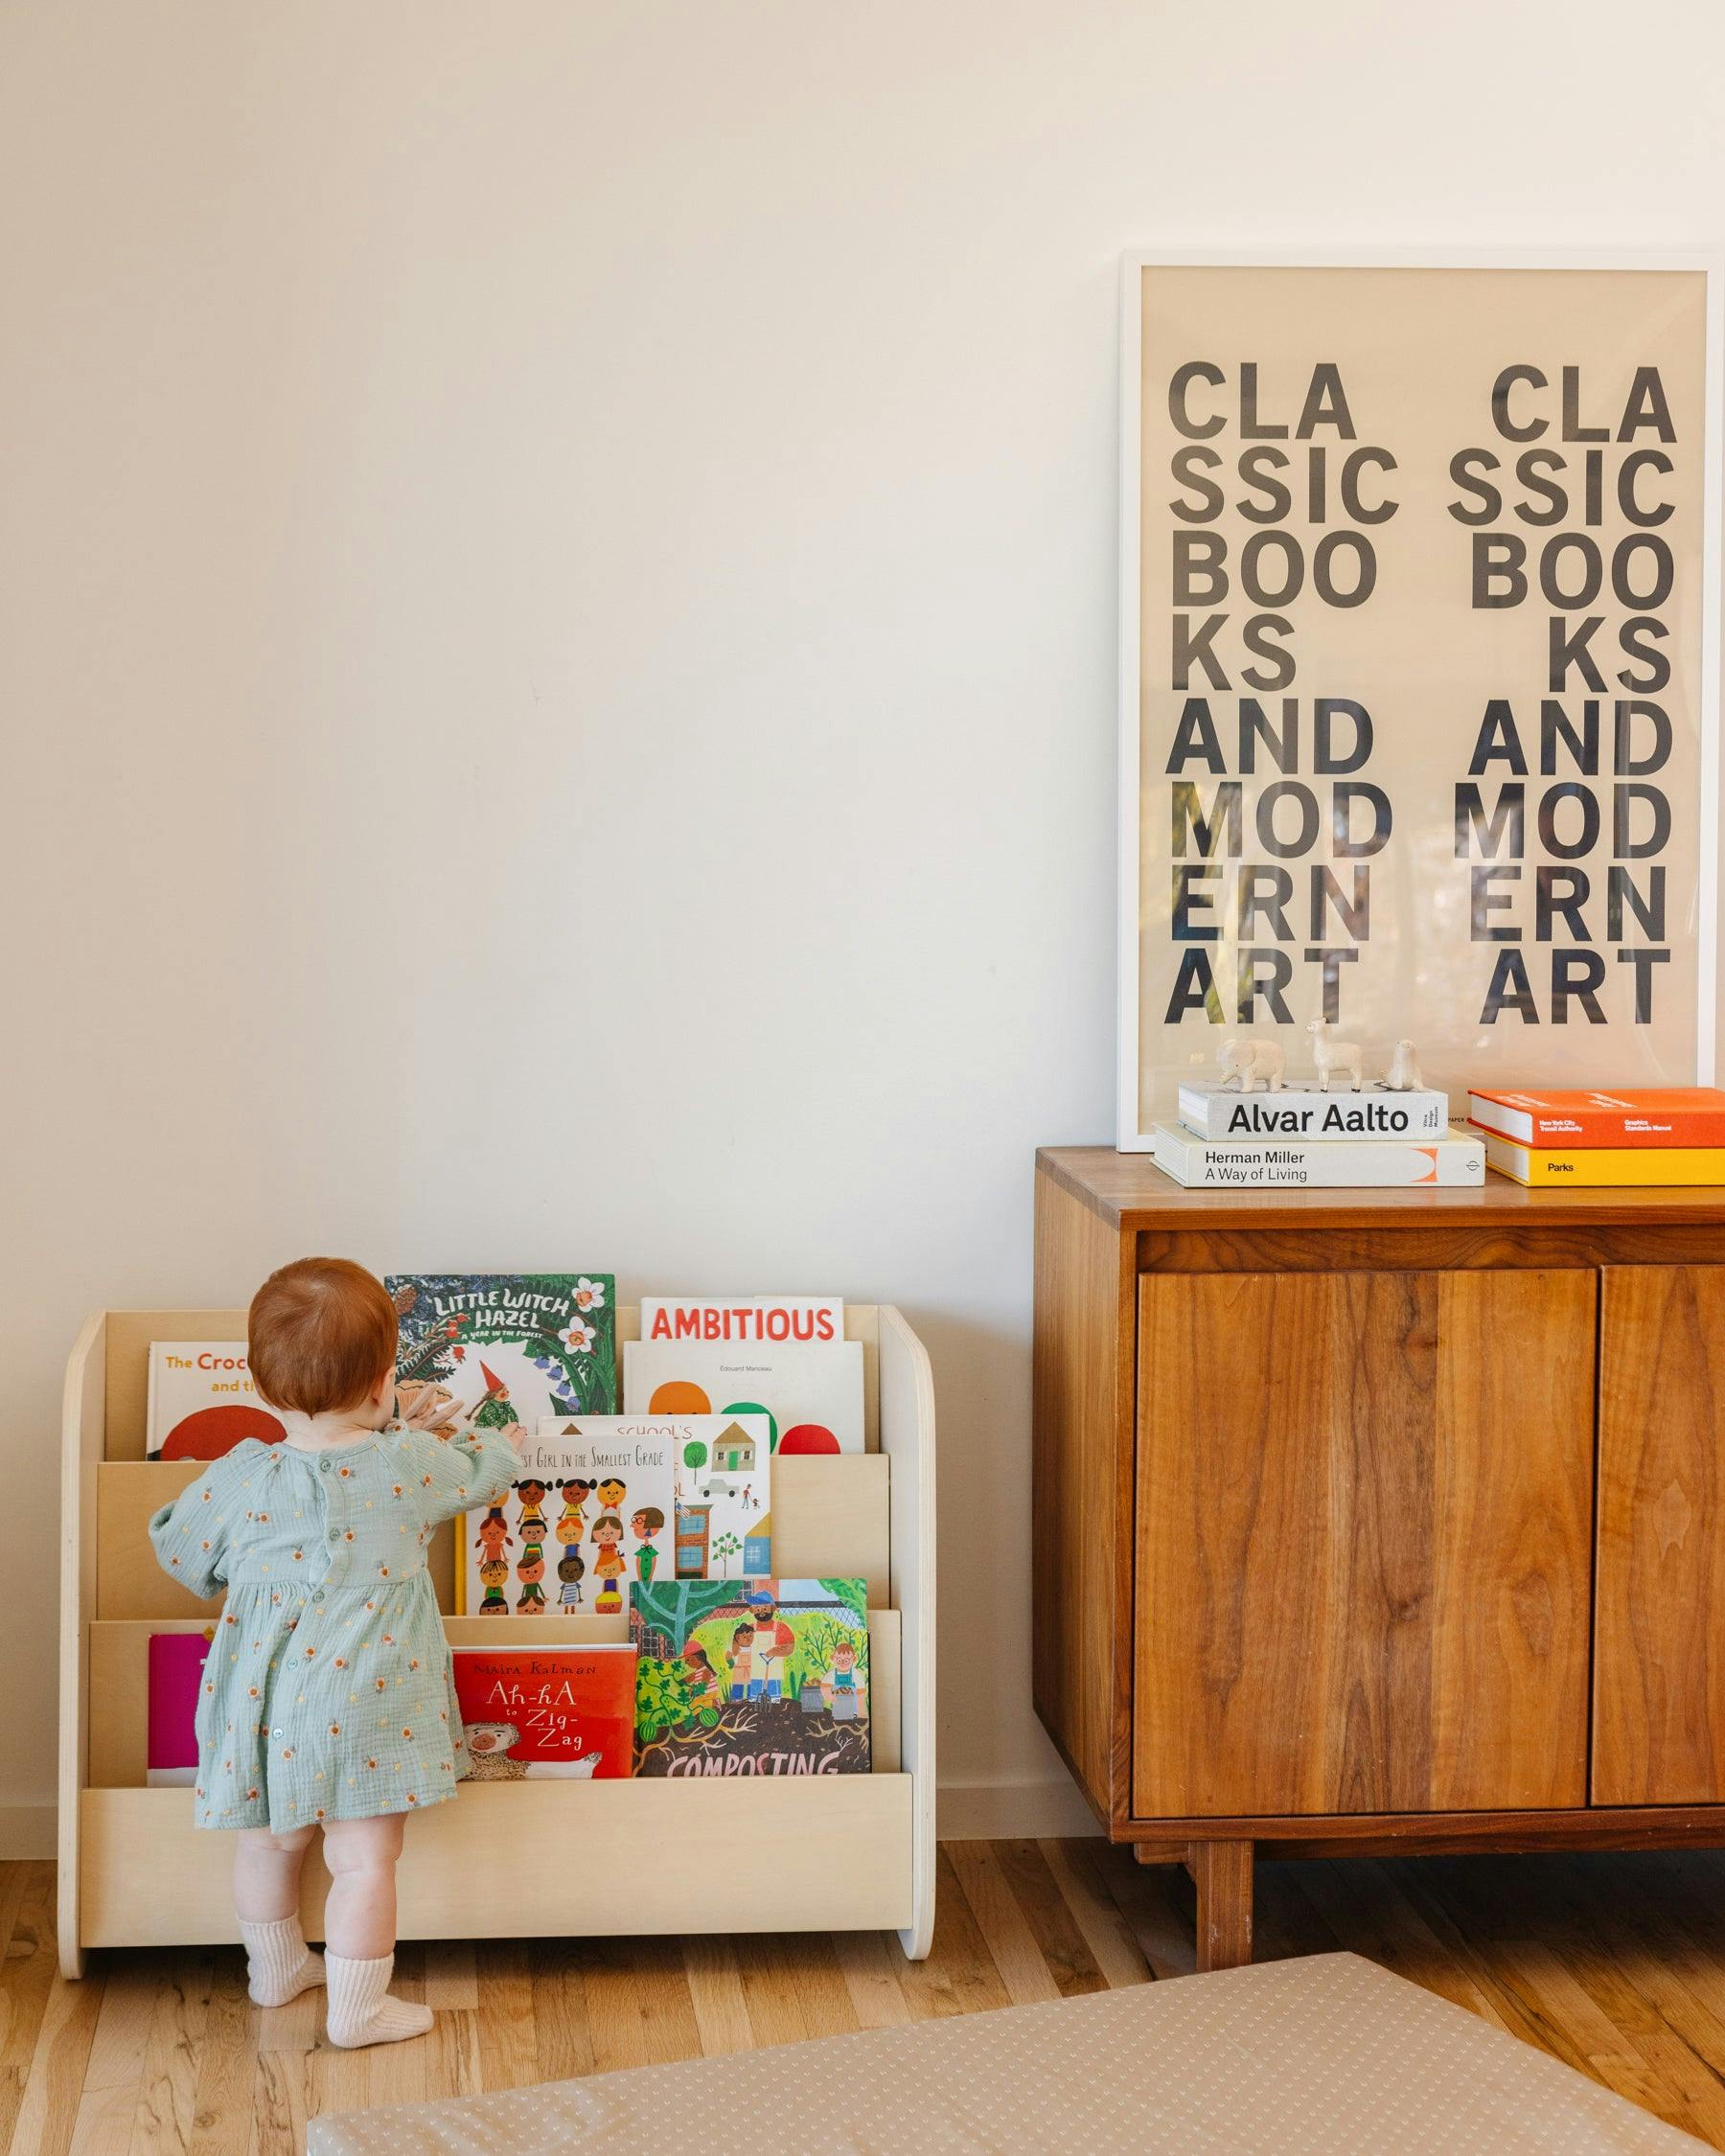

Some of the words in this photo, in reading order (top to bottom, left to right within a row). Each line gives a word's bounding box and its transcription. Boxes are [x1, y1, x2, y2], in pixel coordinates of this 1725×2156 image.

[1168, 361, 1357, 440] CLA
[1492, 365, 1677, 443] CLA
[1168, 446, 1399, 524] SSIC
[1447, 448, 1675, 526] SSIC
[1173, 530, 1376, 608] BOO
[1472, 533, 1674, 609] BOO
[1172, 613, 1297, 691] KS
[1549, 616, 1670, 693] KS
[1165, 699, 1373, 774] AND
[1468, 700, 1672, 775] AND
[1171, 781, 1392, 859] MOD
[1455, 782, 1671, 860] MOD
[1171, 865, 1369, 941] ERN
[1471, 866, 1666, 942] ERN
[1164, 948, 1358, 1024] ART
[1480, 949, 1670, 1024] ART
[1229, 1104, 1313, 1133] Alvar
[1322, 1104, 1409, 1132] Aalto
[1206, 1152, 1260, 1163] Herman
[1265, 1151, 1305, 1163] Miller
[1206, 1168, 1215, 1180] A
[1218, 1168, 1247, 1183] Way
[1251, 1167, 1264, 1180] of
[1268, 1168, 1307, 1183] Living
[1548, 1162, 1575, 1172] Parks
[434, 1291, 499, 1317] LITTLE
[503, 1289, 570, 1317] WITCH
[470, 1330, 490, 1340] YEAR
[516, 1330, 543, 1339] FOREST
[475, 1310, 540, 1329] HAZEL
[651, 1308, 834, 1341] AMBITIOUS
[165, 1356, 193, 1368] The
[197, 1353, 246, 1370] Croc
[211, 1380, 240, 1391] and
[537, 1446, 558, 1468] GIRL
[562, 1454, 572, 1467] IN
[575, 1454, 586, 1467] THE
[591, 1446, 632, 1468] SMALLEST
[635, 1445, 663, 1467] GRADE
[525, 1709, 578, 1730] Zig-
[537, 1728, 583, 1751] Zag
